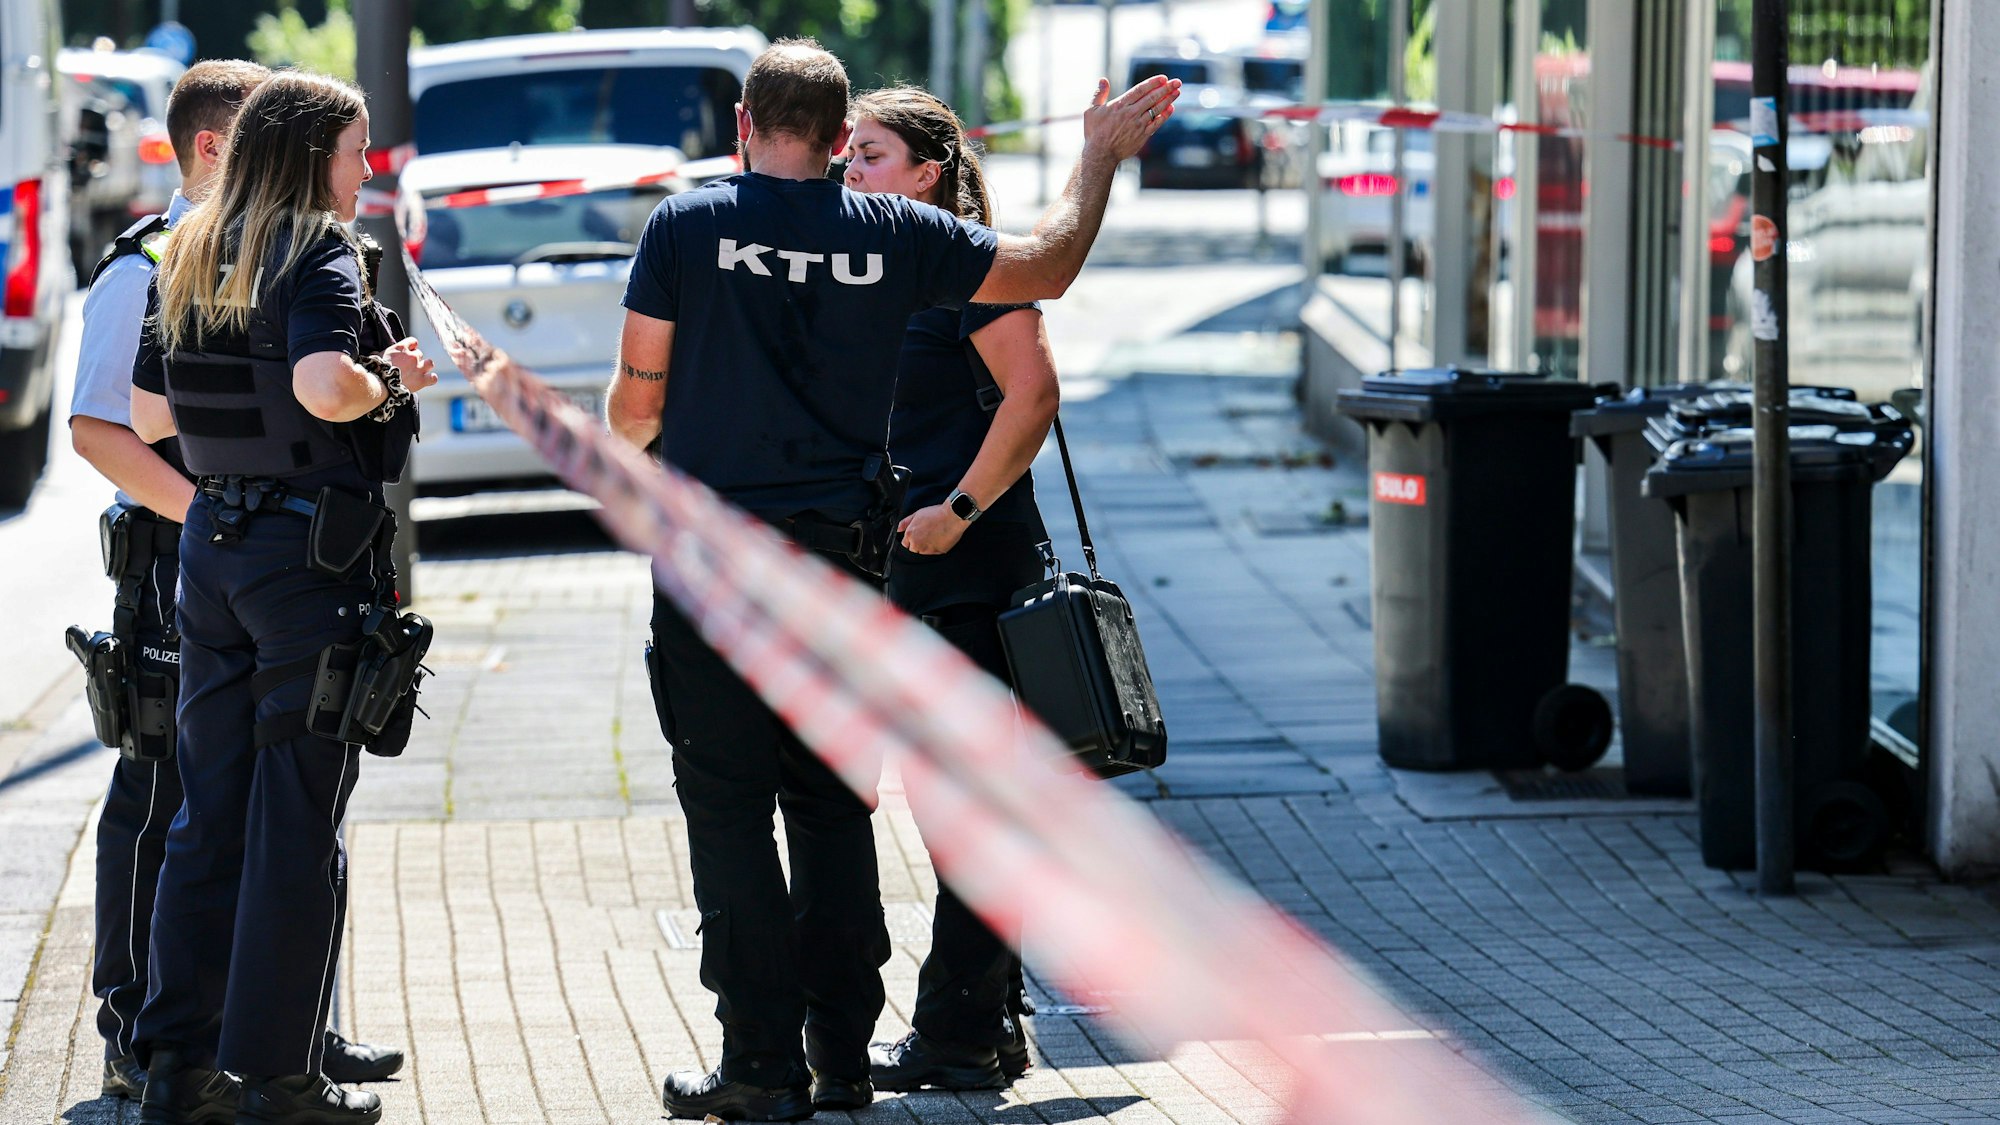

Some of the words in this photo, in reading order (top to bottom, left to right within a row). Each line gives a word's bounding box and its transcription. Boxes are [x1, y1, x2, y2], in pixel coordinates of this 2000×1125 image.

[717, 237, 884, 285] KTU
[1377, 476, 1418, 500] SULO
[143, 645, 181, 664] POLIZE
